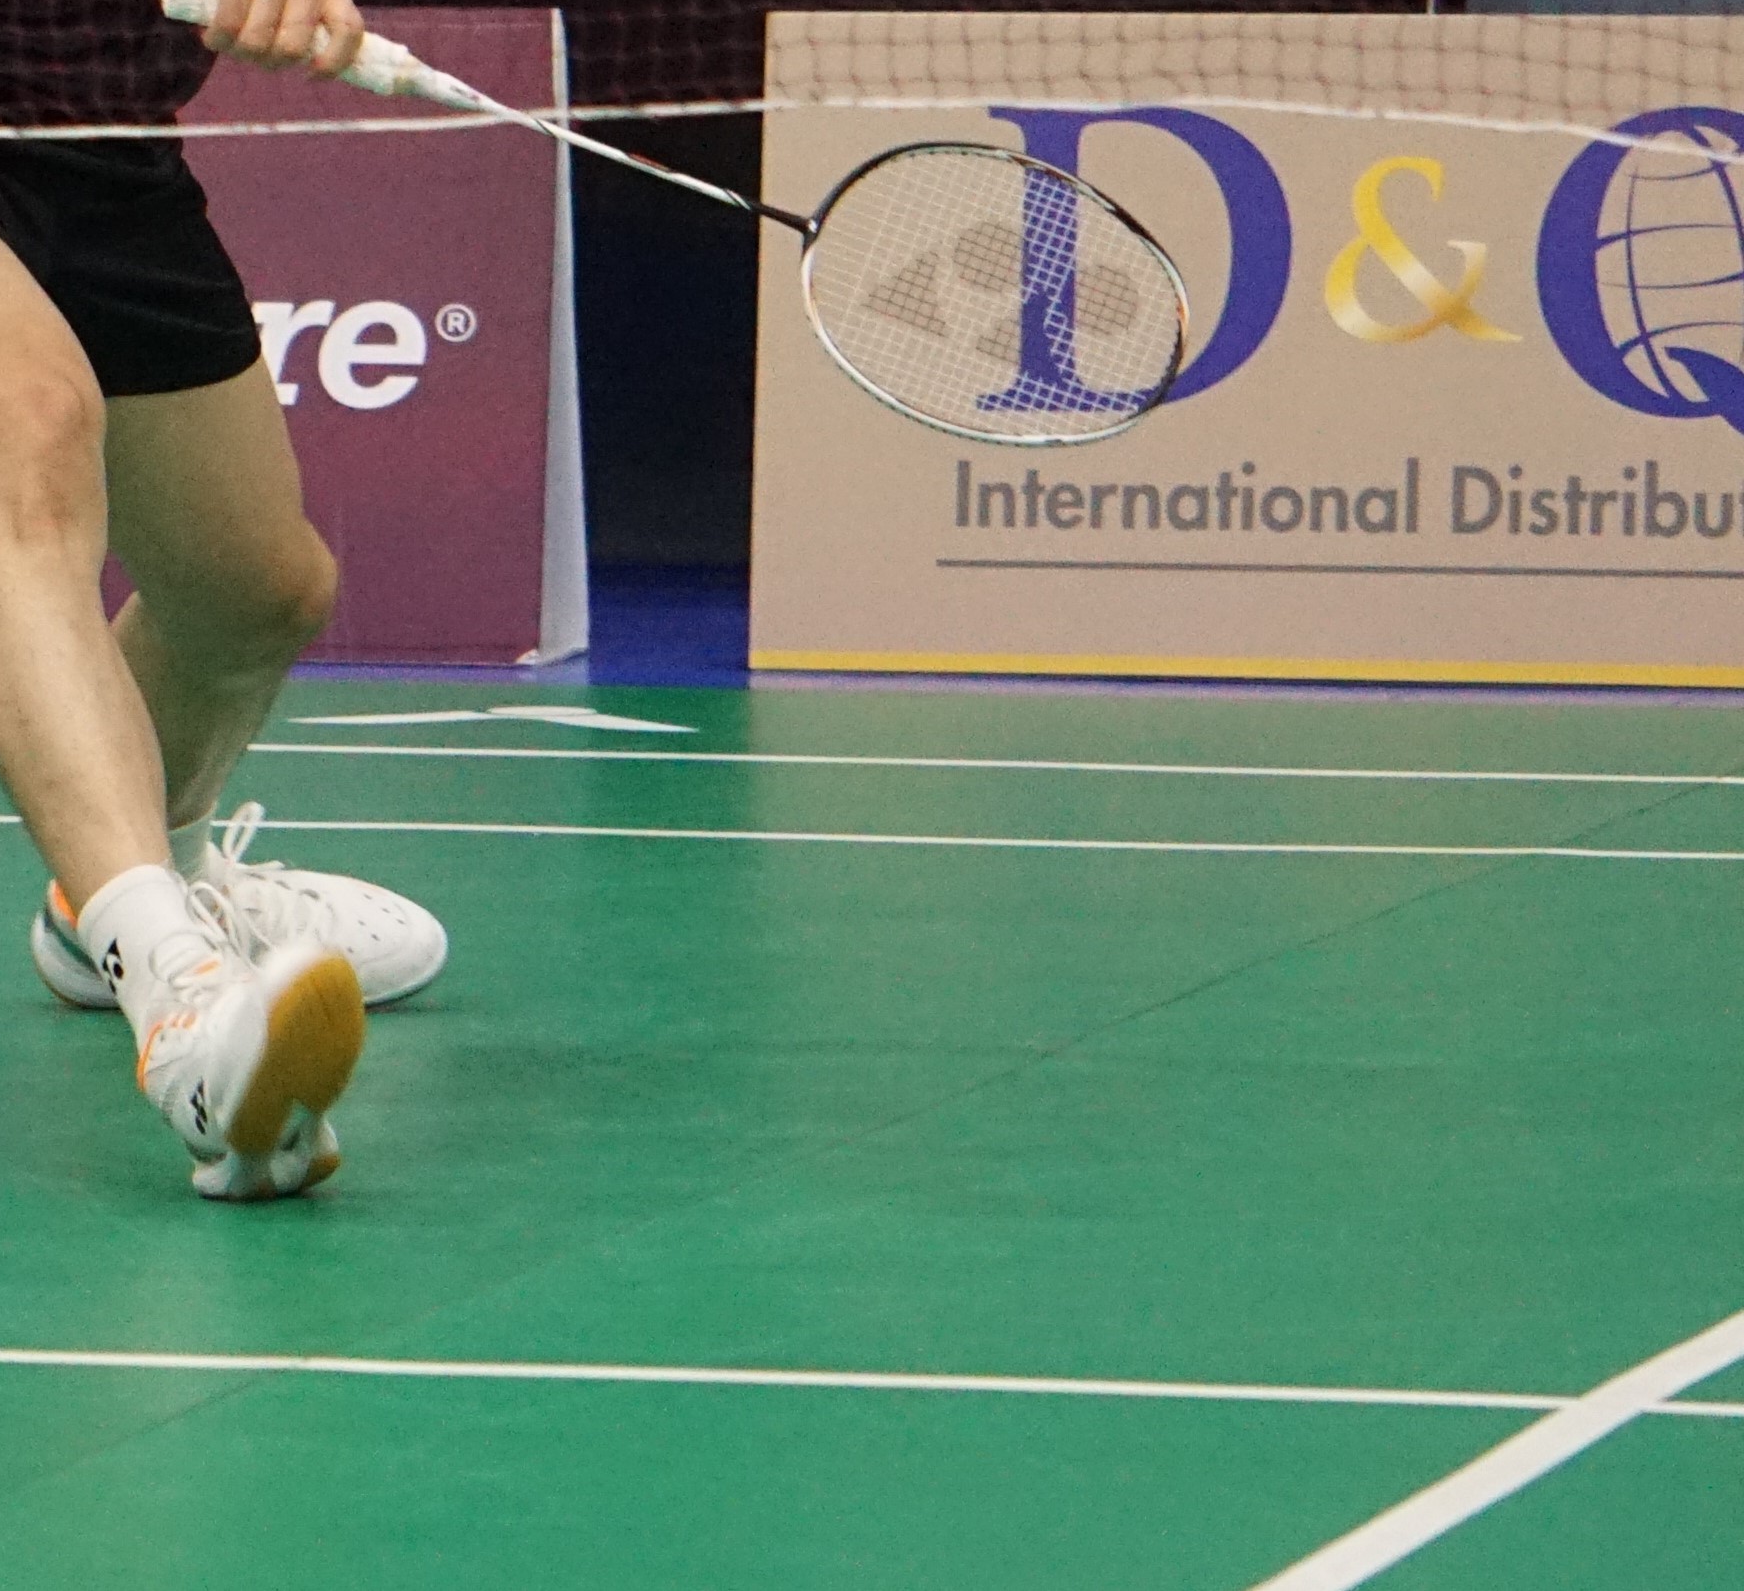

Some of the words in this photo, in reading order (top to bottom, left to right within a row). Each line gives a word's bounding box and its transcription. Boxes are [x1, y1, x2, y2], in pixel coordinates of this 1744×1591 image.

[976, 107, 1292, 411] D
[1324, 154, 1523, 344] &
[1535, 107, 1744, 435] Q
[955, 457, 1420, 533] International
[1451, 459, 1744, 540] Distribu
